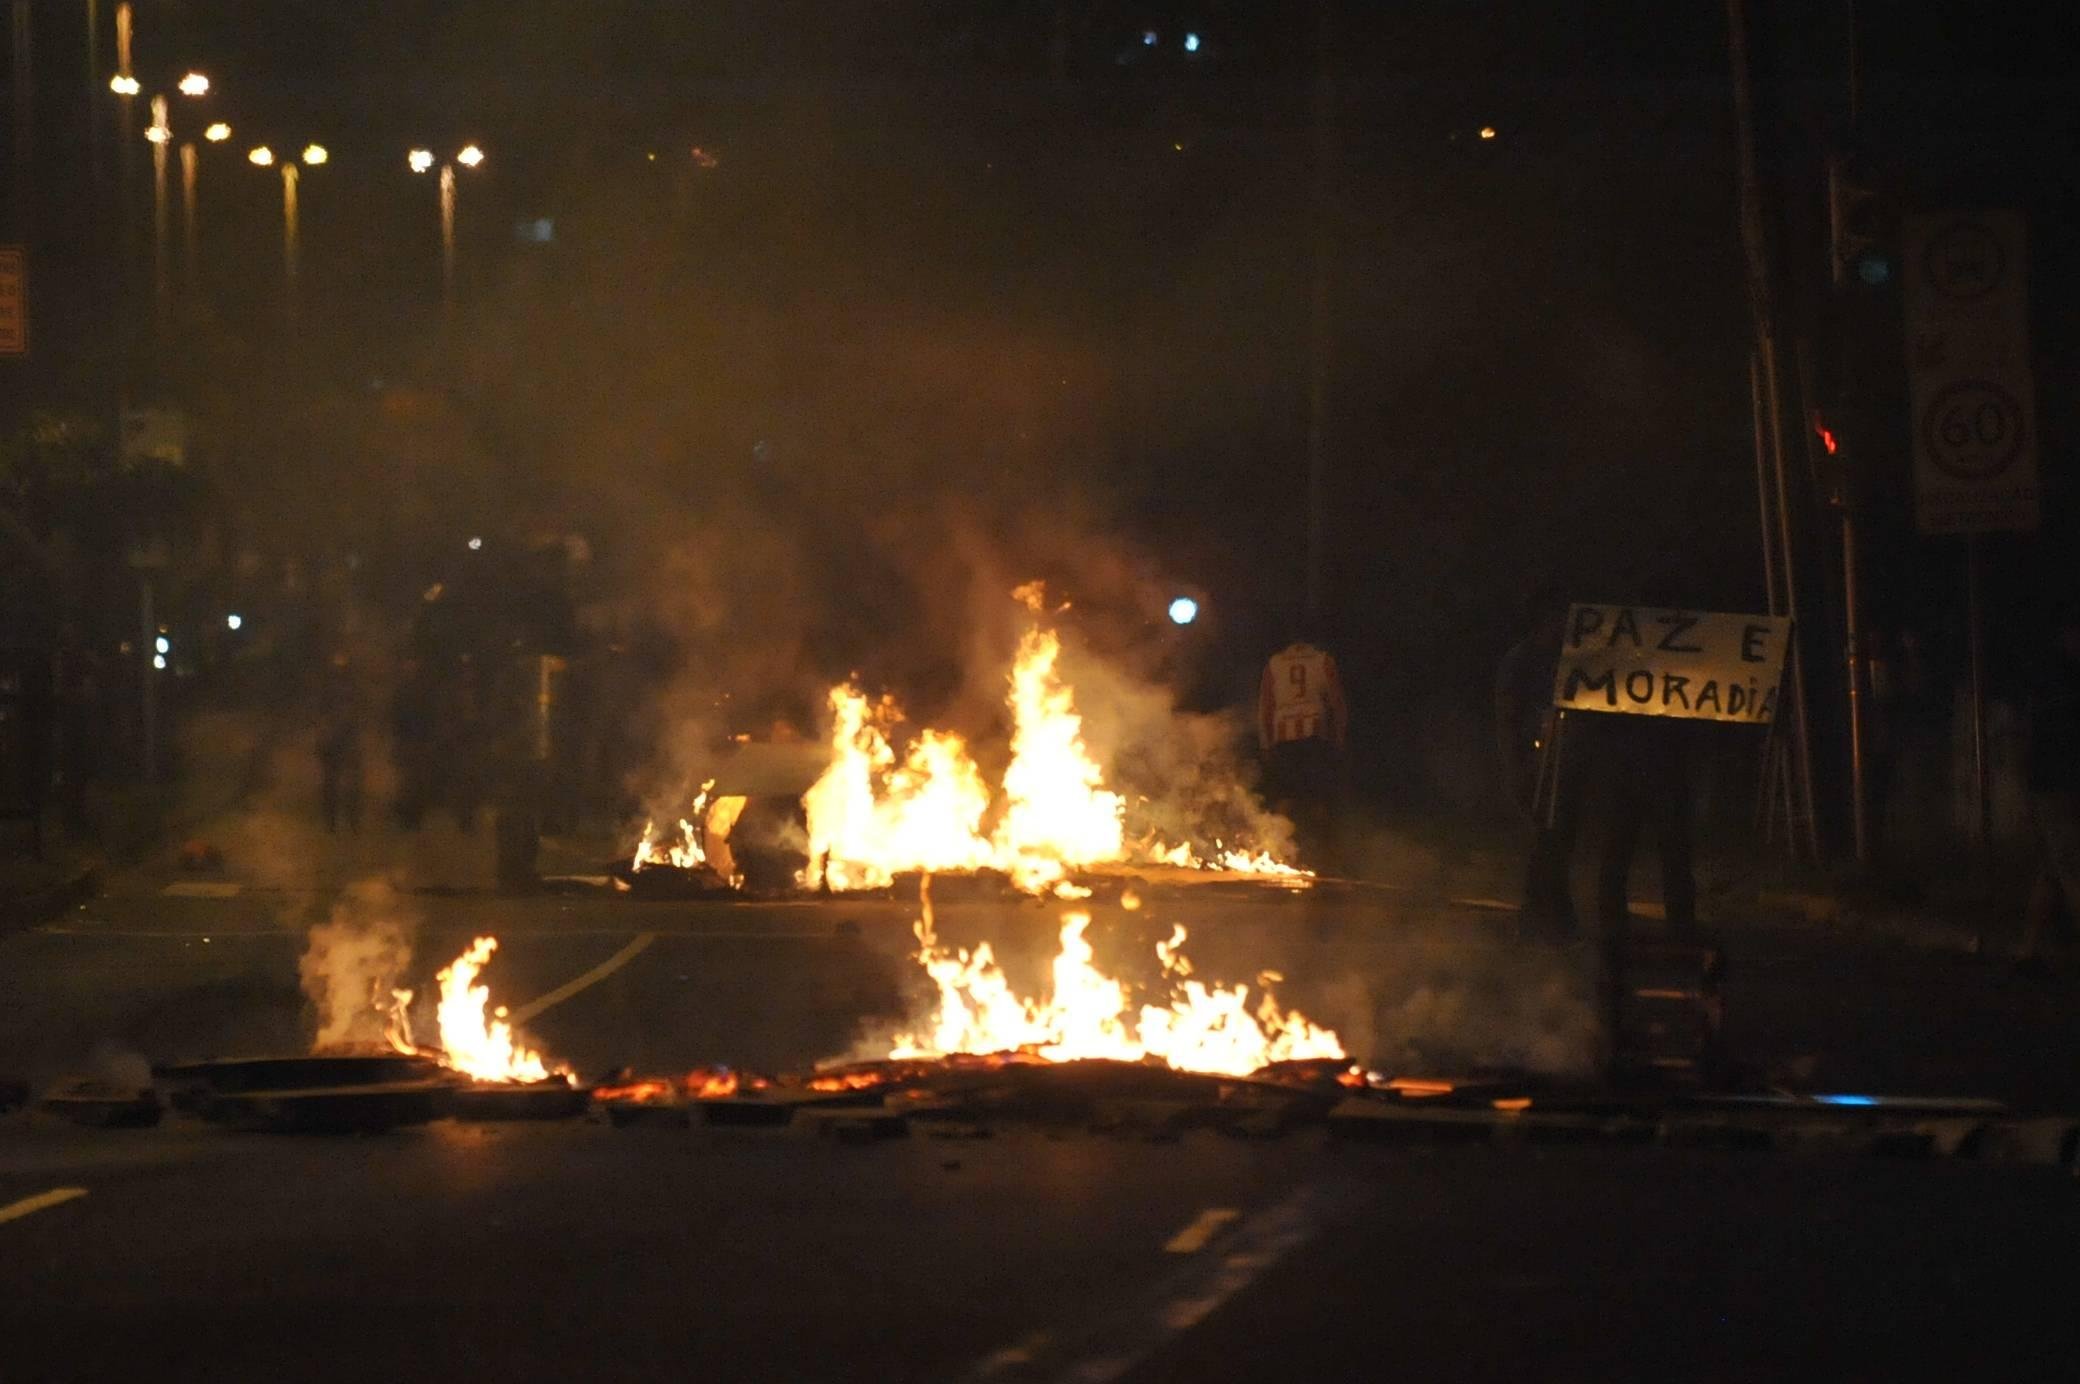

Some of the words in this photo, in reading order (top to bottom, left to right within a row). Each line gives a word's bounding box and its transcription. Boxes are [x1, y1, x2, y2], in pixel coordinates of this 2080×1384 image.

[1941, 400, 2005, 446] 60
[1573, 607, 1702, 653] PAZ
[1742, 624, 1771, 663] E
[1289, 662, 1306, 699] 9
